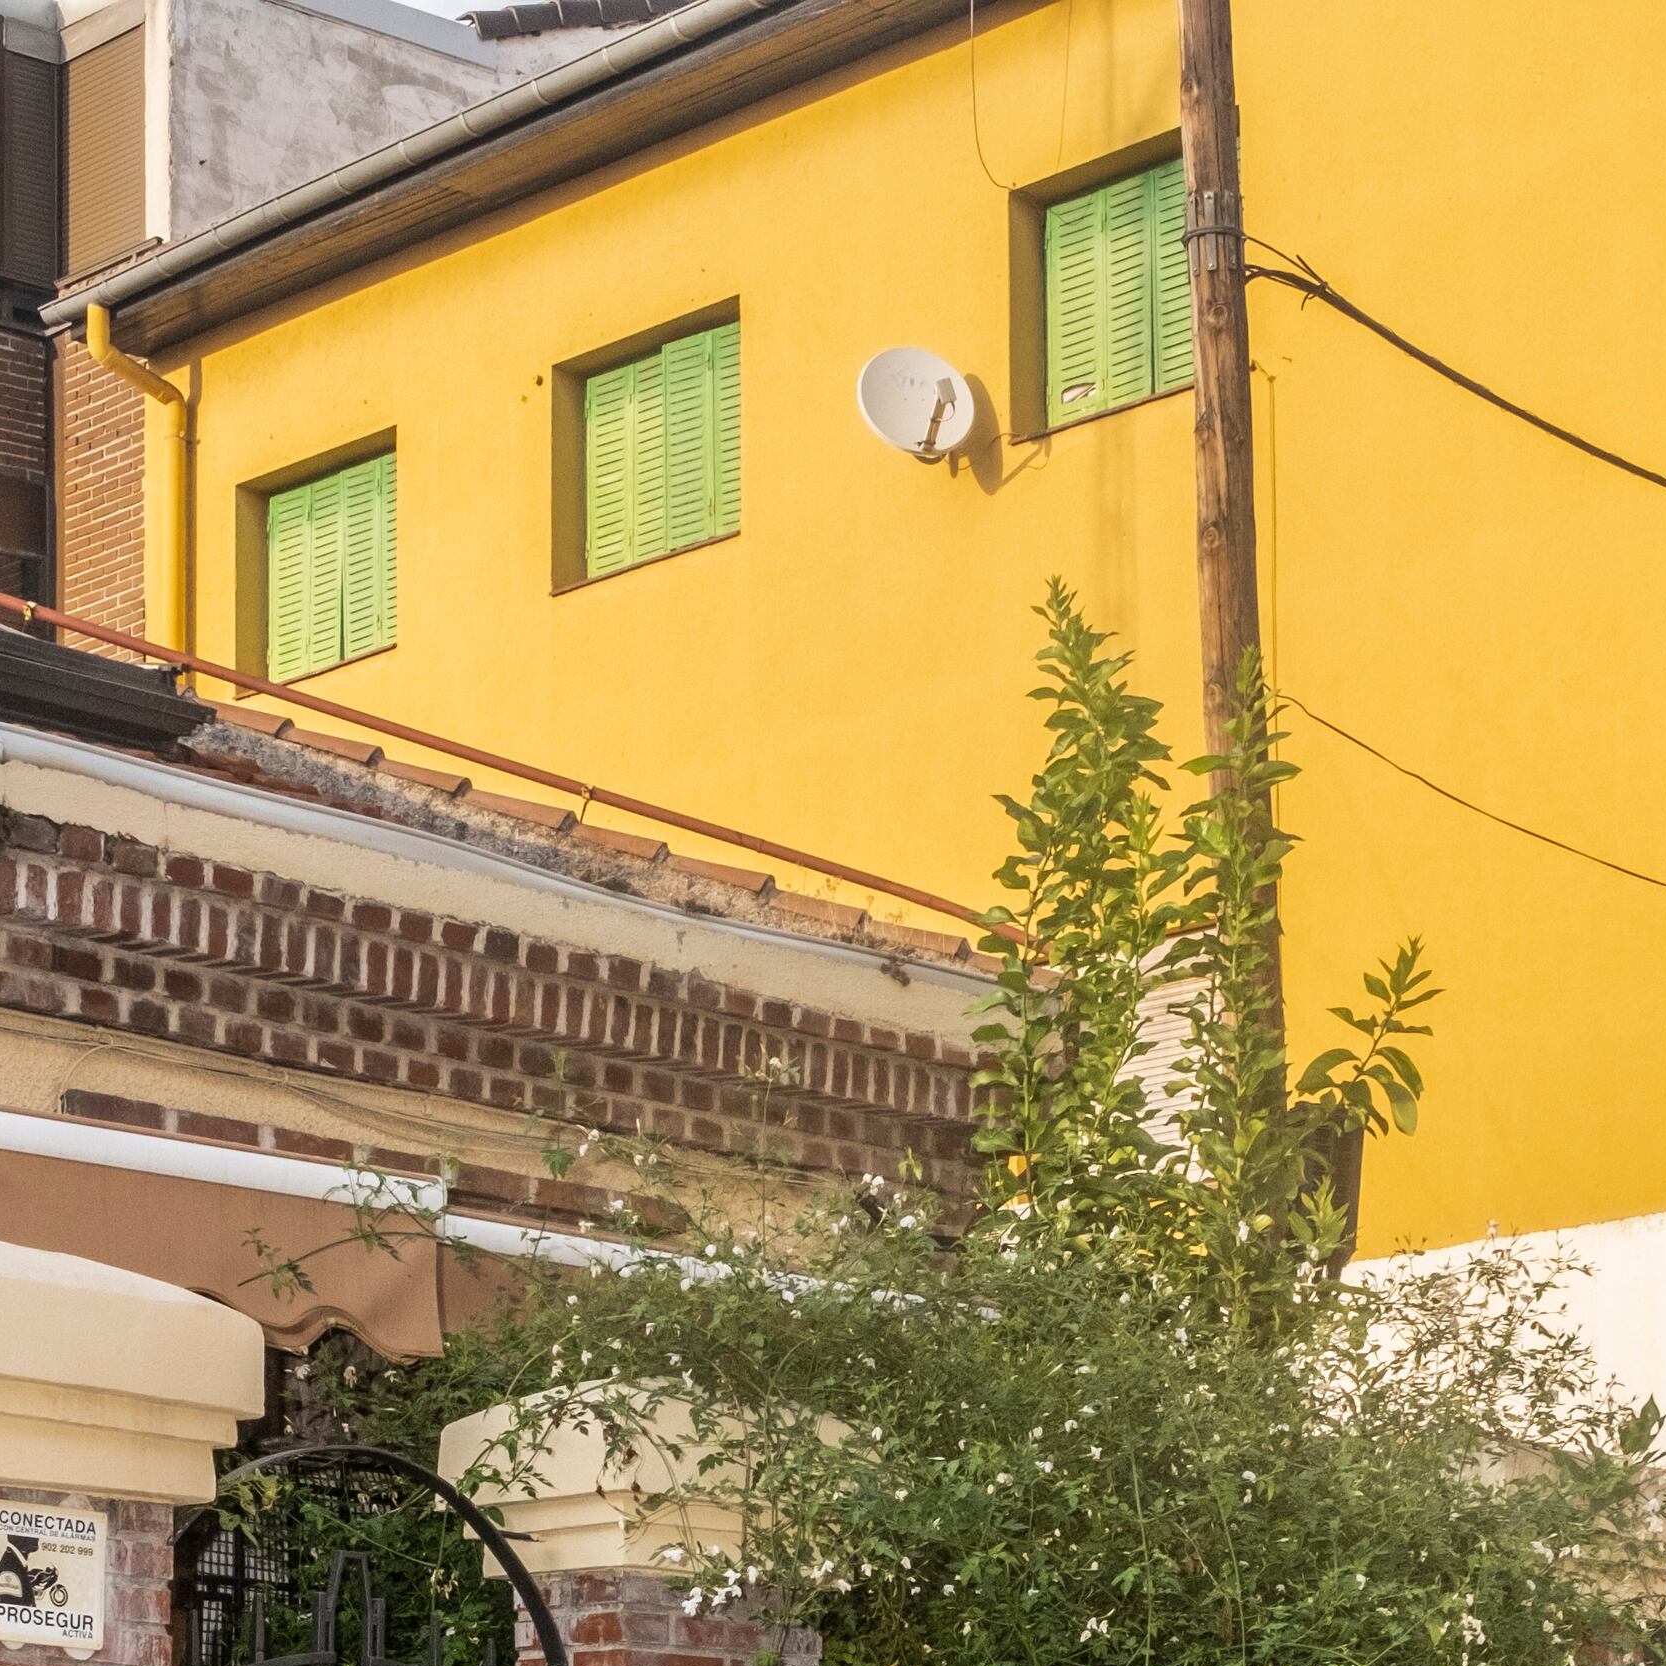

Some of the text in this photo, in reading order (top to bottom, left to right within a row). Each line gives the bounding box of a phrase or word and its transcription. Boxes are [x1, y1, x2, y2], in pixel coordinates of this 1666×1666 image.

[15, 1525, 47, 1537] CENTRAL
[49, 1530, 59, 1538] DE
[60, 1531, 96, 1543] ALARMAS
[41, 1542, 93, 1557] 902 202 999
[62, 1629, 93, 1640] ACTIVA
